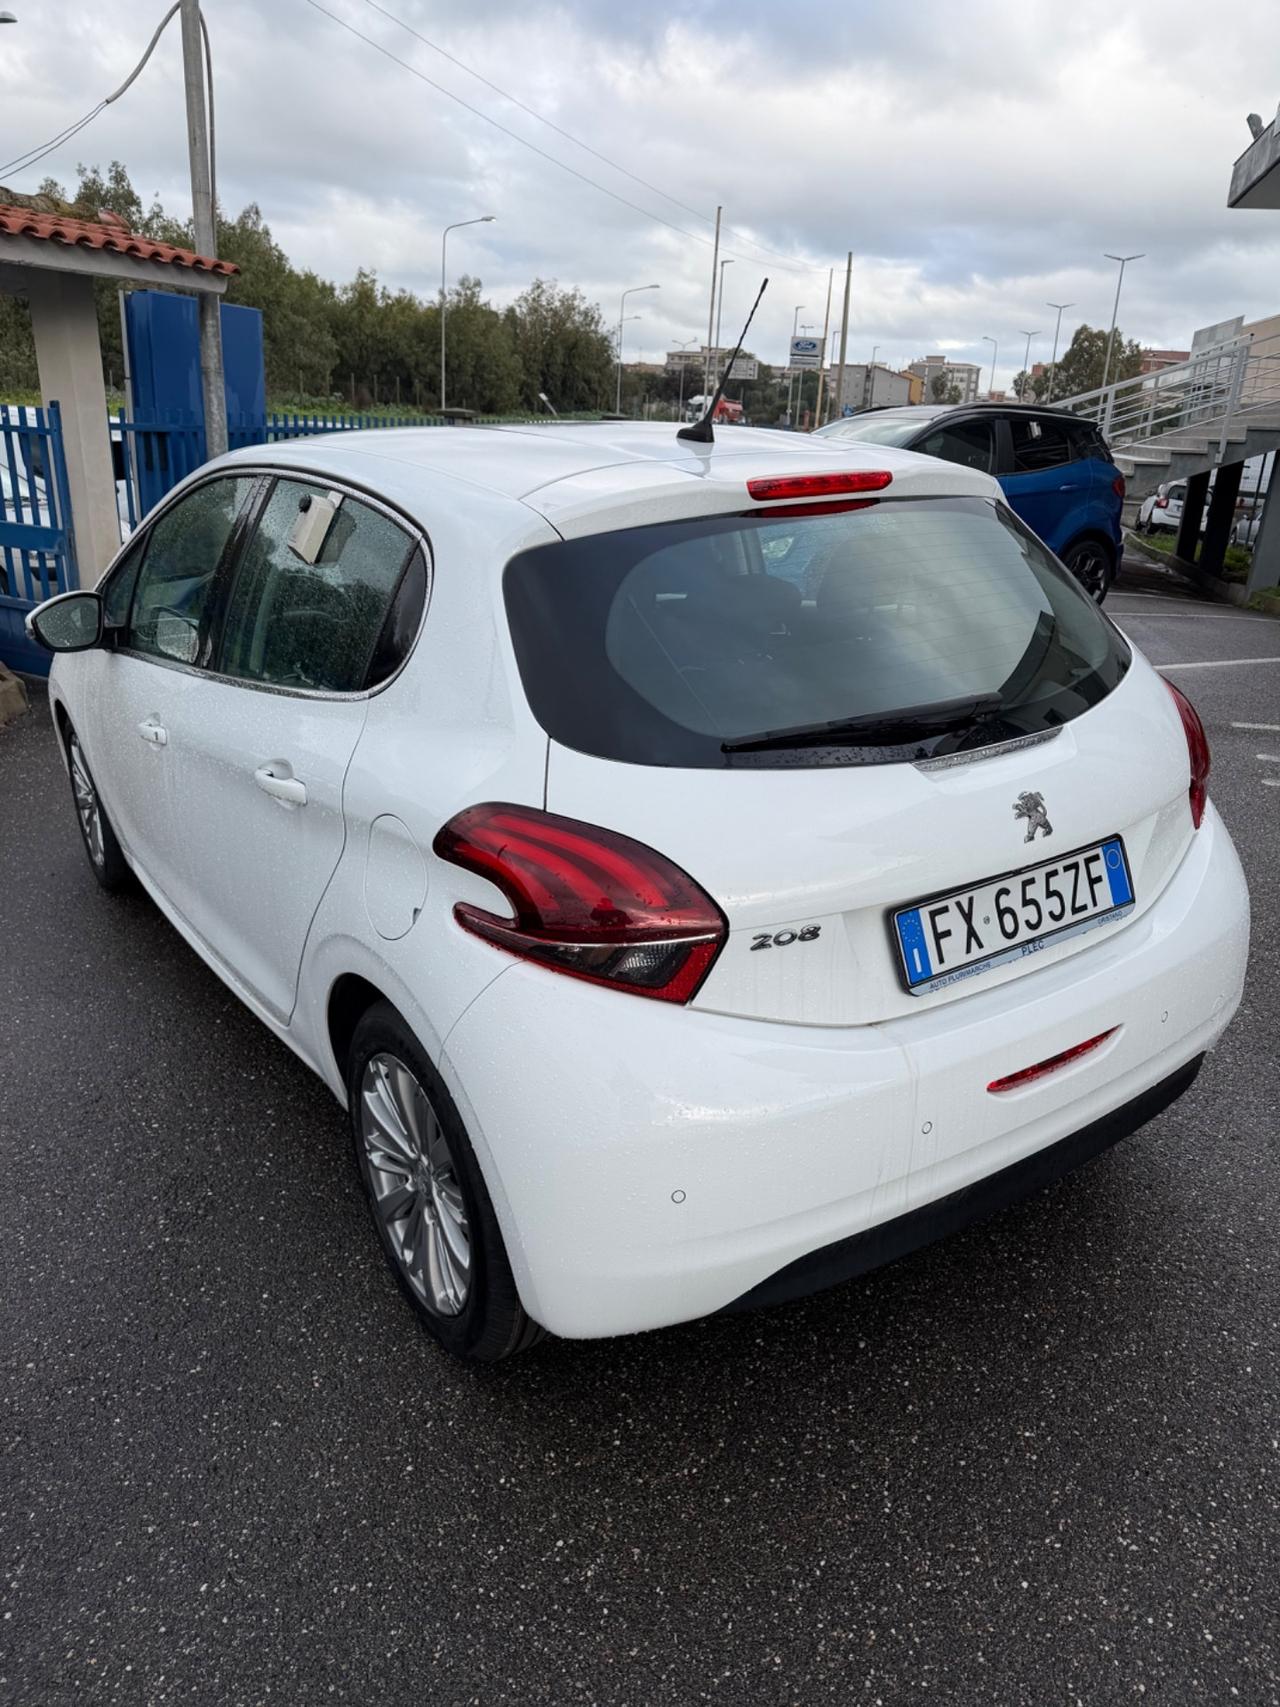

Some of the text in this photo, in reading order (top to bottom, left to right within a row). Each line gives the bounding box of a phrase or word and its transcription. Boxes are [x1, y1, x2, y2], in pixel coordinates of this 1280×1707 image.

[928, 853, 1104, 965] FX 655ZF
[750, 924, 822, 951] 208
[1021, 940, 1045, 956] PLEC
[929, 978, 948, 989] AUTO
